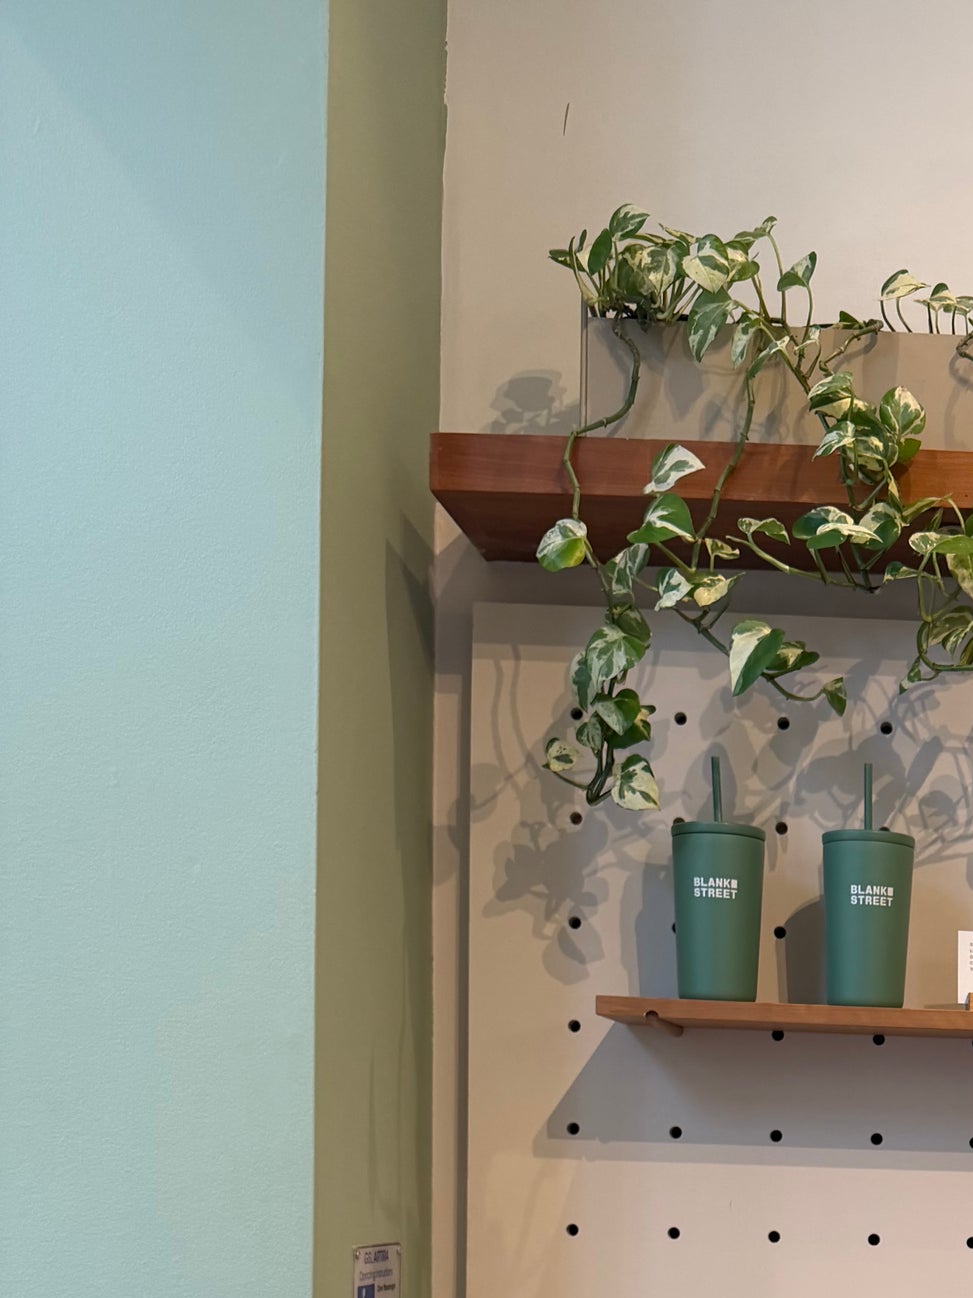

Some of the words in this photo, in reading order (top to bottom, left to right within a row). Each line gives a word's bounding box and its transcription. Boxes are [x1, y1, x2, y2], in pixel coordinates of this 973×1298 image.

[694, 877, 731, 888] BLANK
[694, 887, 738, 899] STREET
[850, 884, 887, 896] BLANK
[850, 895, 893, 907] STREET
